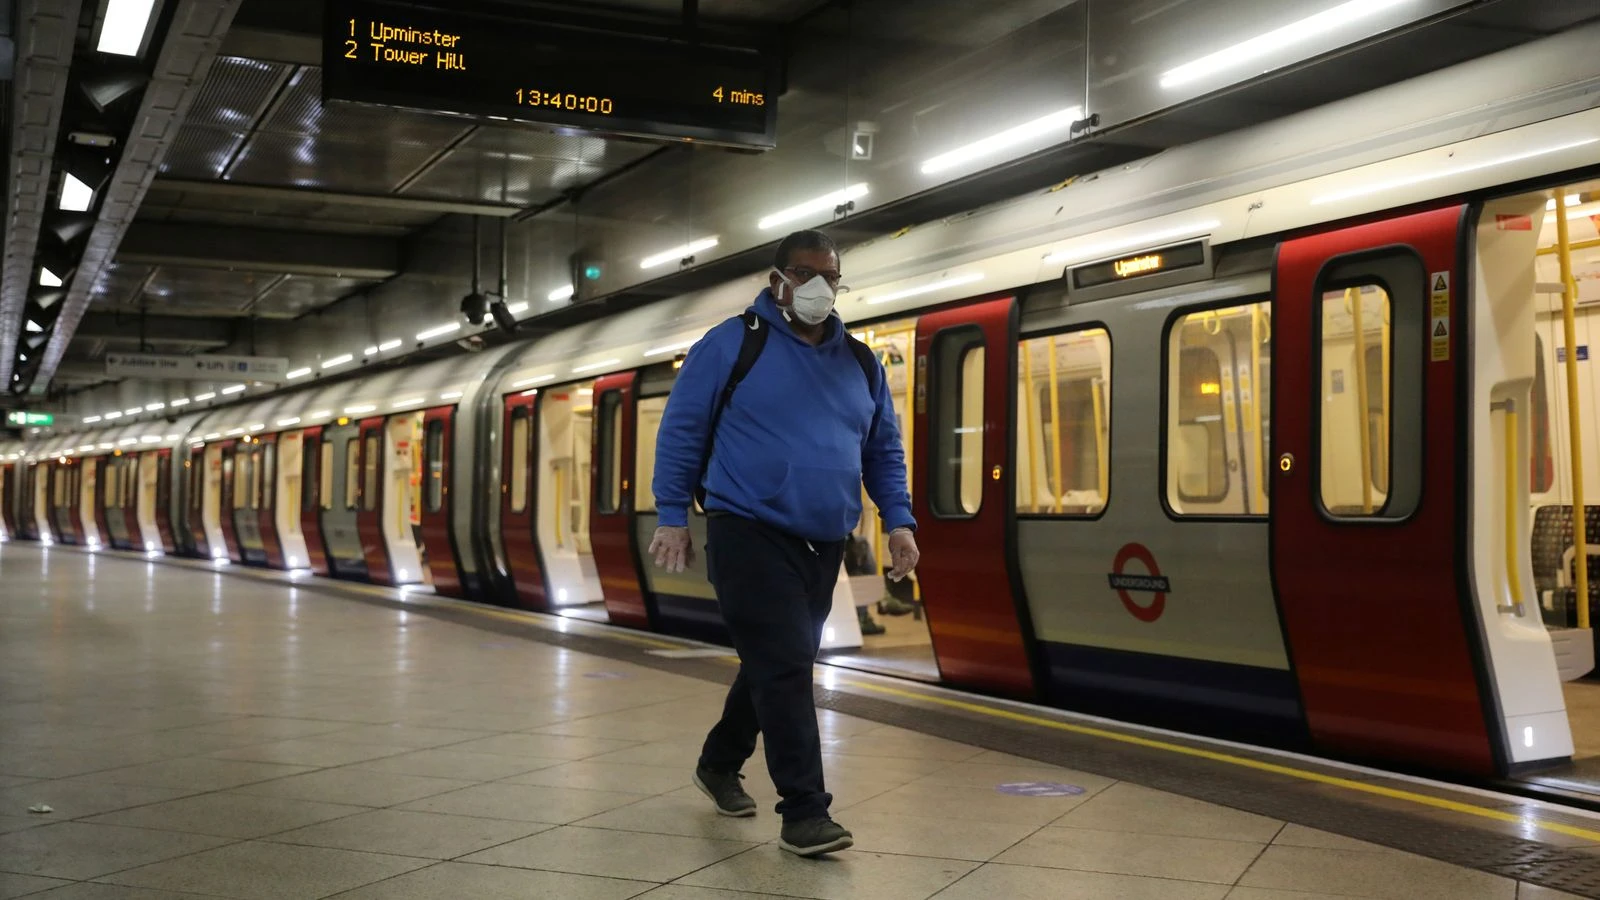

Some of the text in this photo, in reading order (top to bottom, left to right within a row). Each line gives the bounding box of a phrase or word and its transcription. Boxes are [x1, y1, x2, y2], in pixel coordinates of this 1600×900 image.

[348, 18, 461, 48] 1 Upminster
[344, 39, 466, 71] 2 Tower Hill
[515, 88, 613, 114] 13:40:00
[712, 86, 764, 107] 4 mins
[1111, 576, 1167, 590] UNDERGROUND
